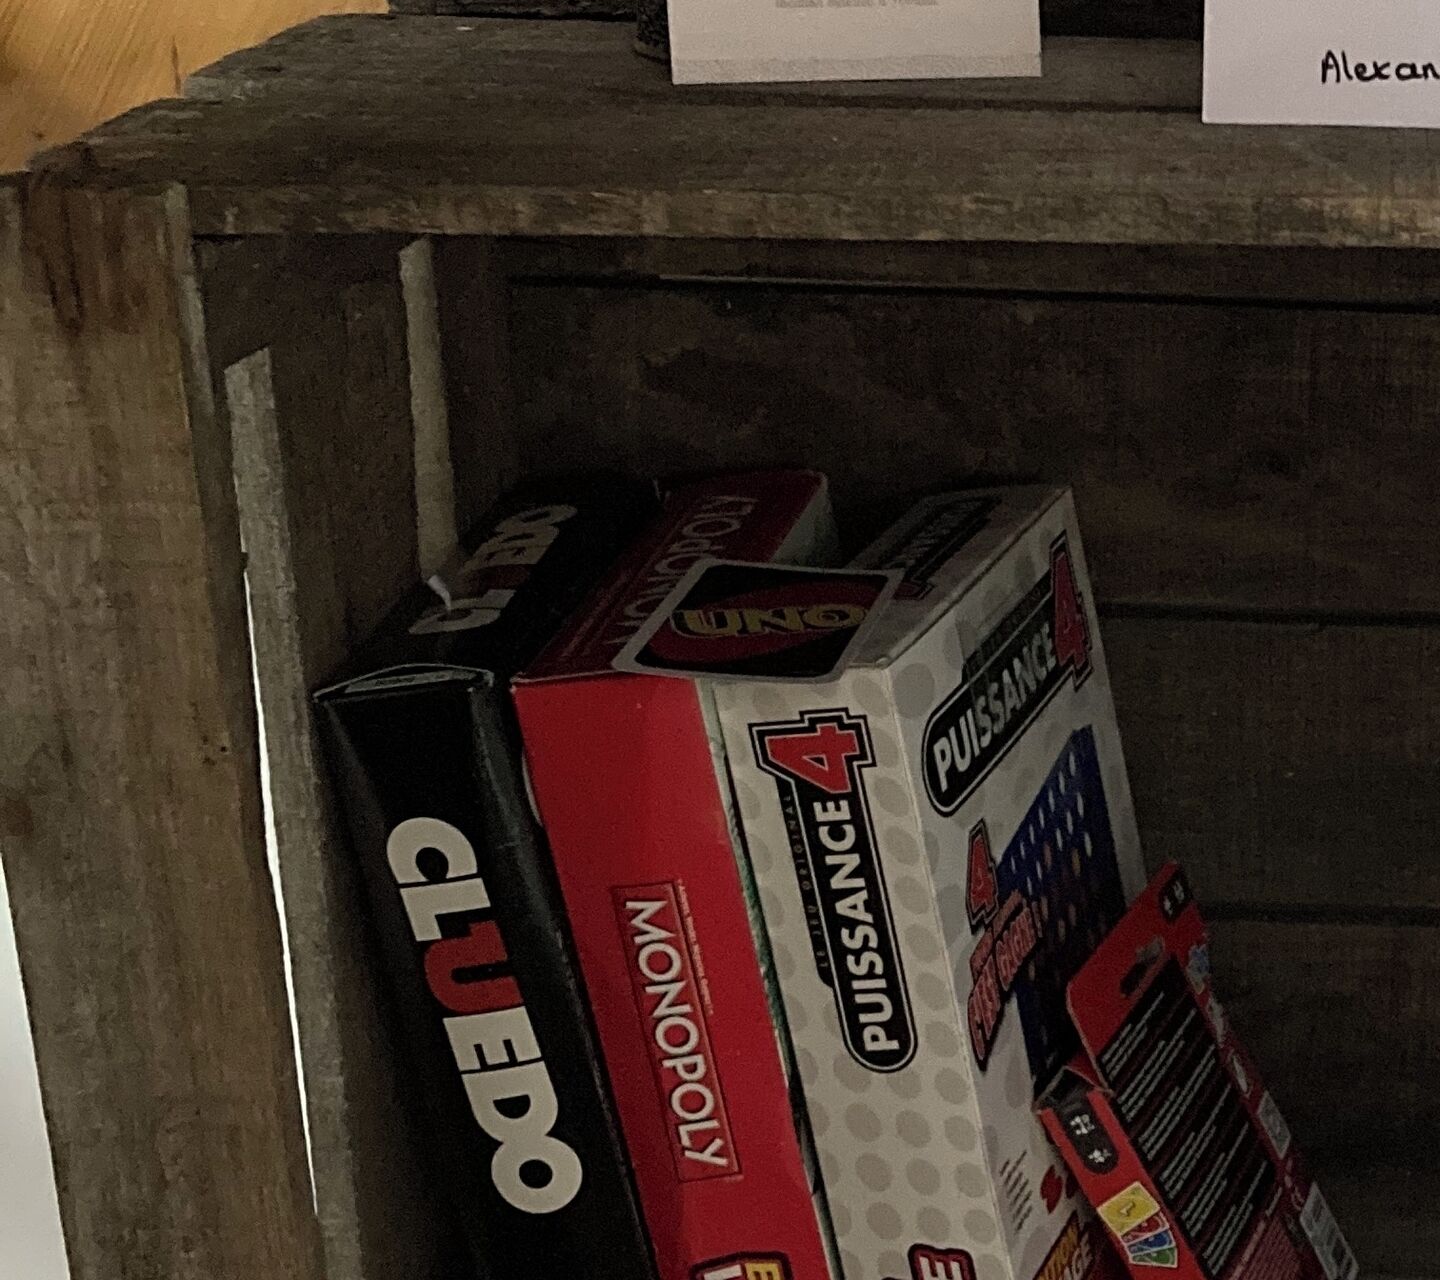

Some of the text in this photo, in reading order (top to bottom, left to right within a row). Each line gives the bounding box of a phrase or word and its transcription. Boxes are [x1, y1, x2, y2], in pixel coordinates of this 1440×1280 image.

[670, 603, 867, 638] UNO
[933, 621, 1056, 793] PUISSANCE
[386, 816, 584, 1214] CLUEDO
[764, 722, 900, 1053] PUISSANCE 4
[624, 897, 731, 1169] MONOPOLY
